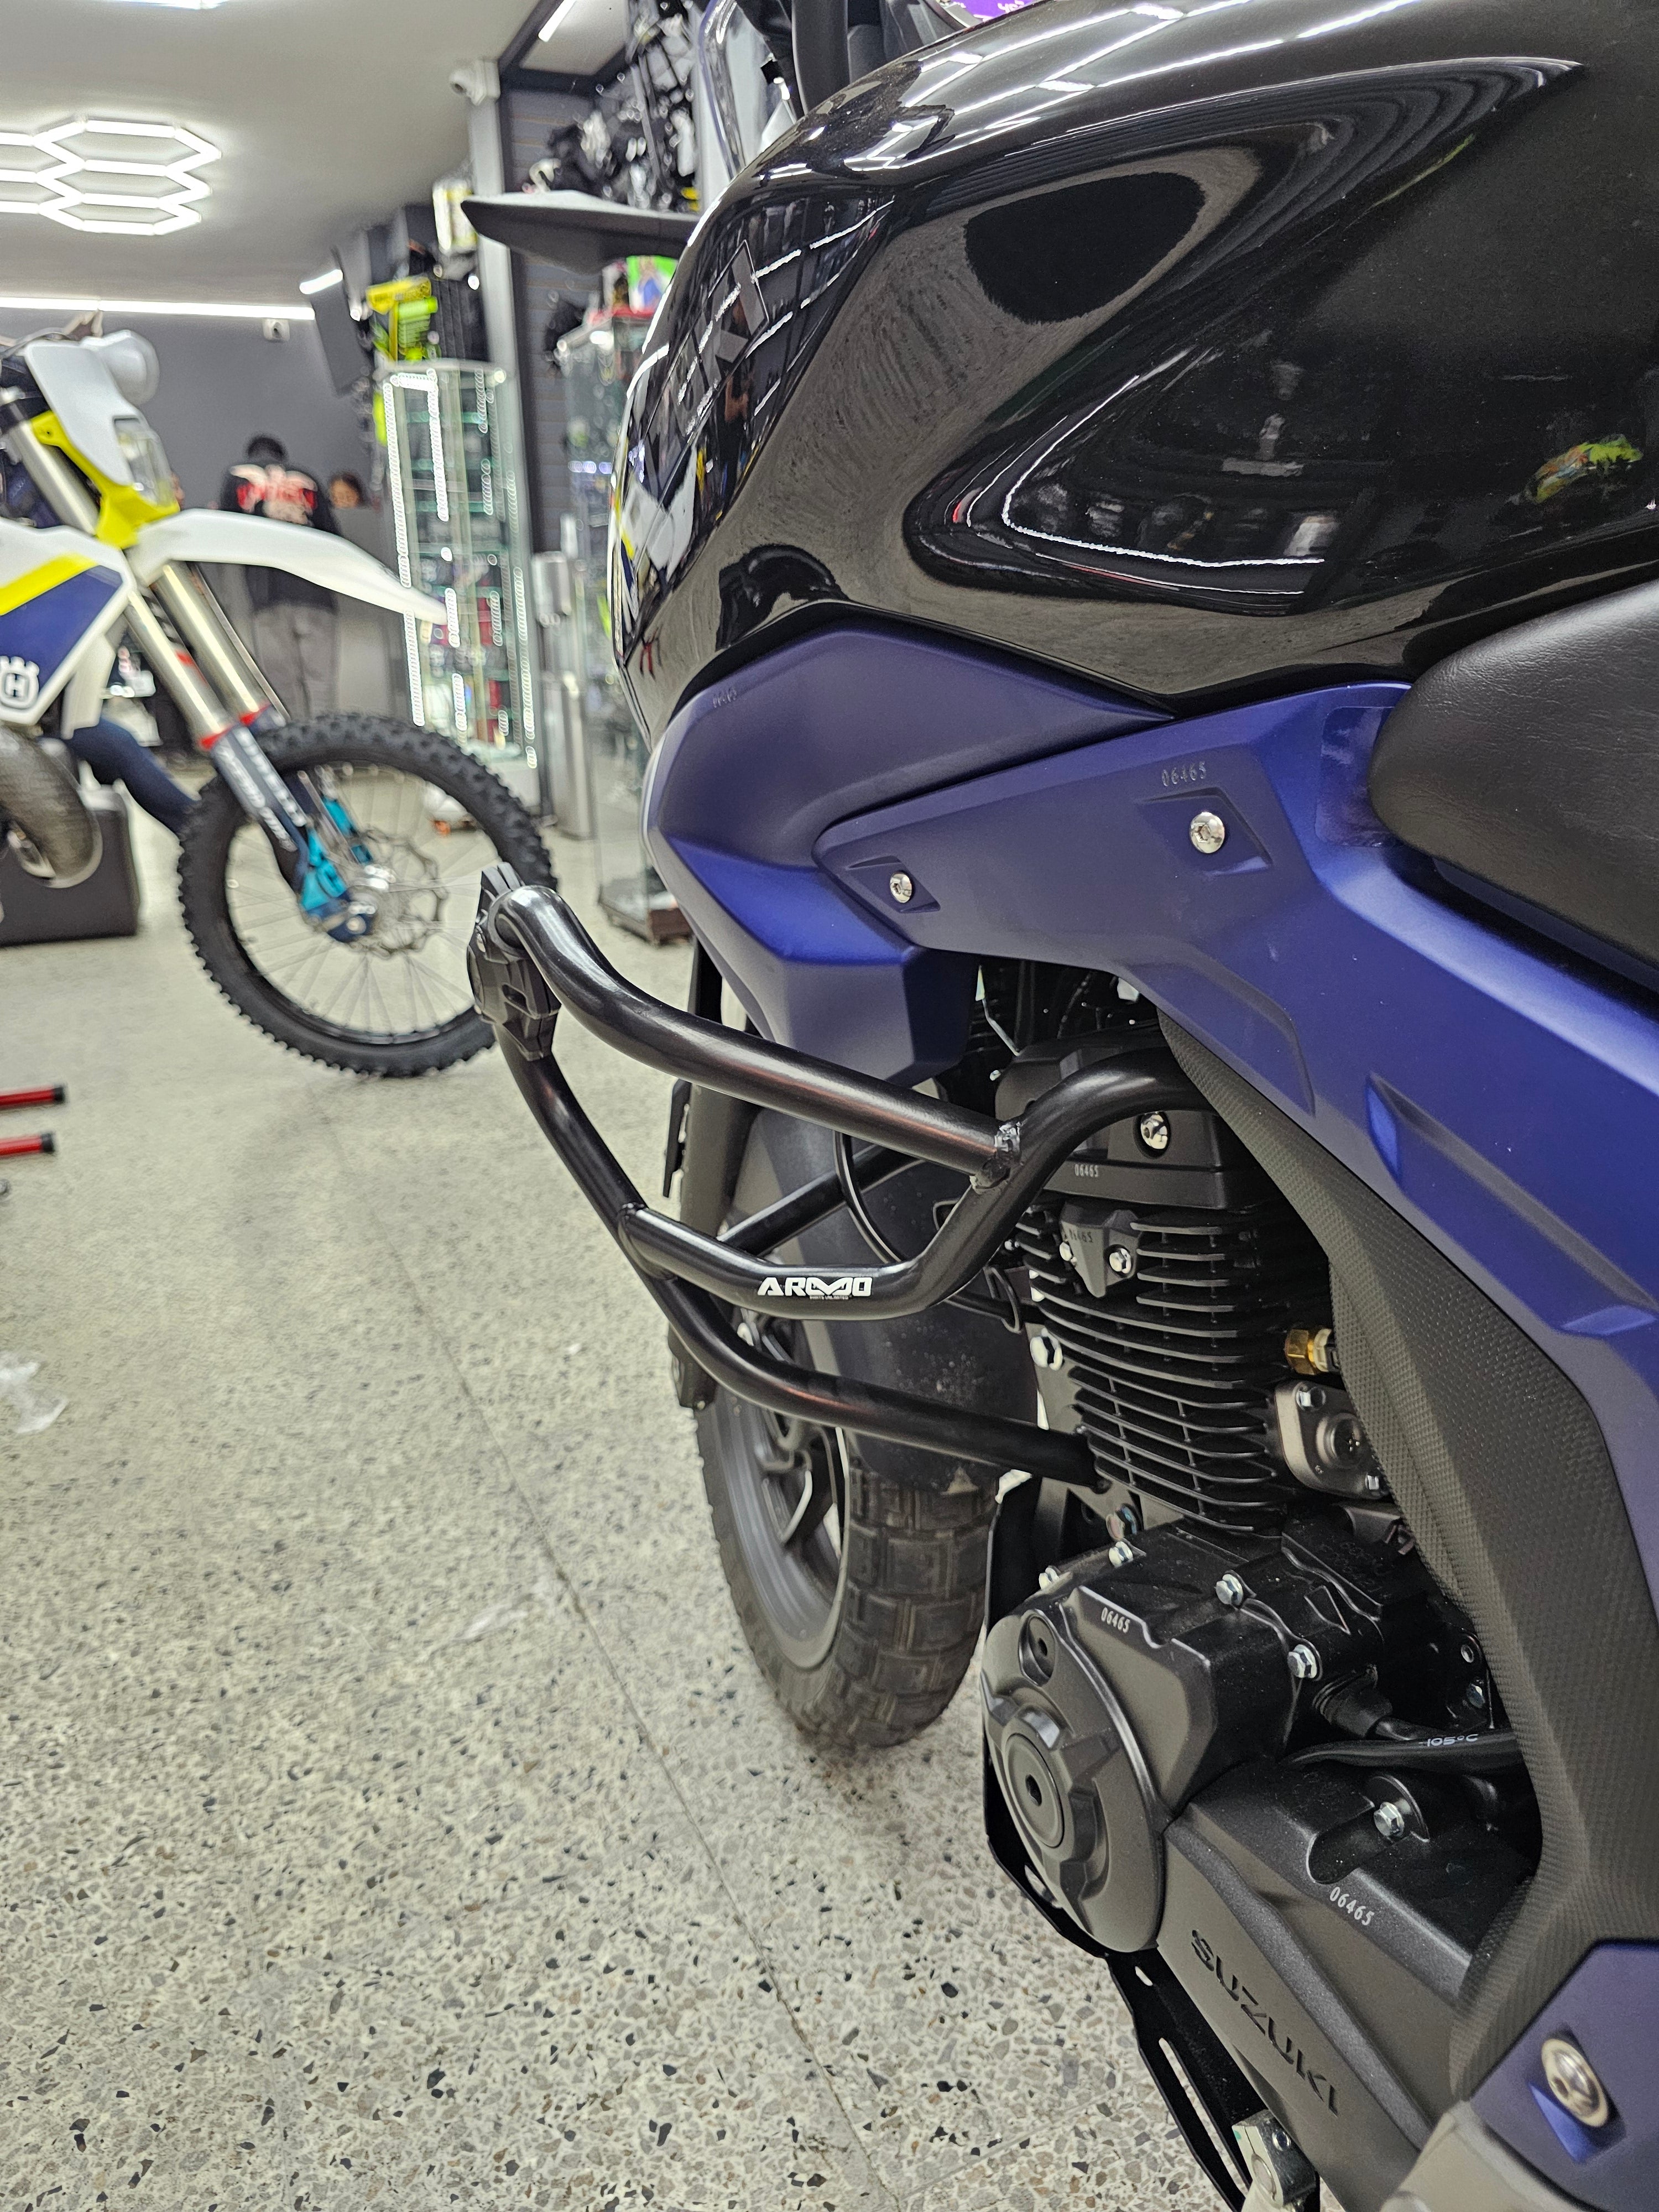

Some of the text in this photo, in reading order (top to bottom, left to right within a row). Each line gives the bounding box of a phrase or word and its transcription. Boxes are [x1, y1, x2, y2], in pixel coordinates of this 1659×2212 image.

[1074, 1164, 1099, 1177] 06465
[1101, 1607, 1130, 1634] 06465
[1329, 1886, 1375, 1926] 06465
[1191, 1929, 1338, 2118] SUZUKI
